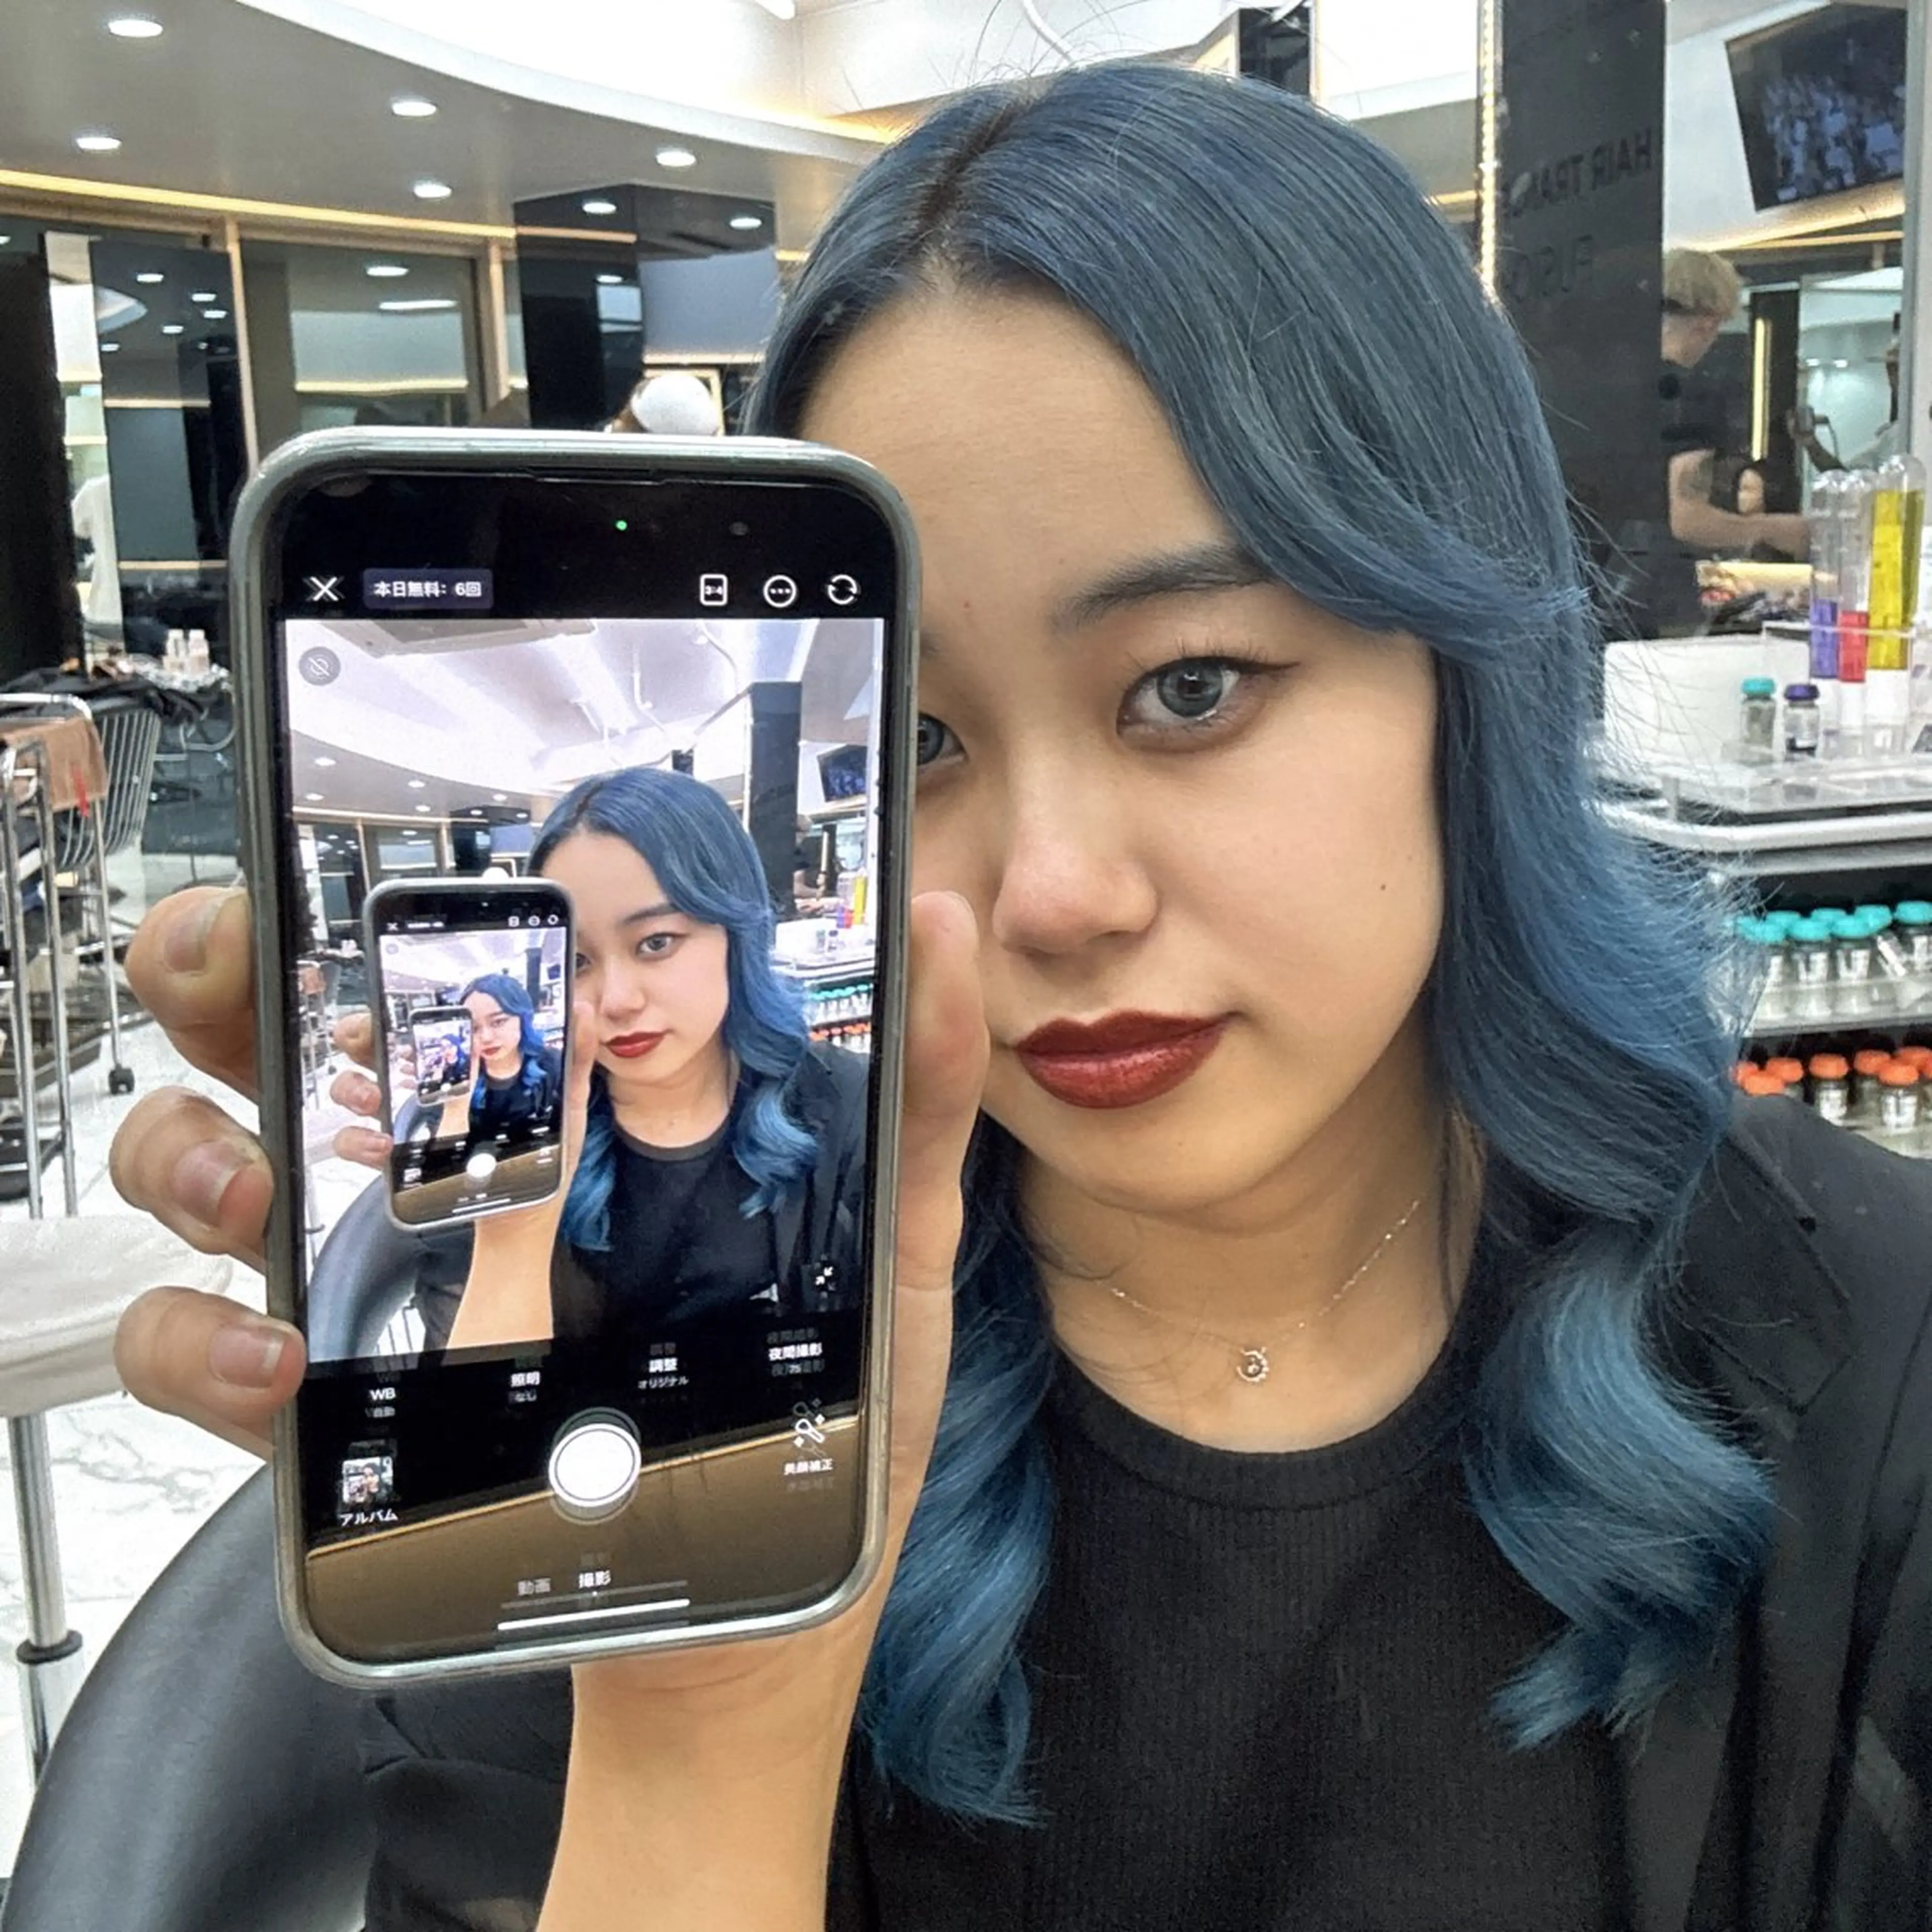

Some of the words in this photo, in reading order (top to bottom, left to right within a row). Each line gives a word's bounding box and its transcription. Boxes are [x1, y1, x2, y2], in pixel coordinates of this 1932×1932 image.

[369, 1388, 395, 1400] WB
[340, 1508, 398, 1526] アルバム
[518, 1578, 551, 1596] 動画
[579, 1570, 611, 1589] 撮影
